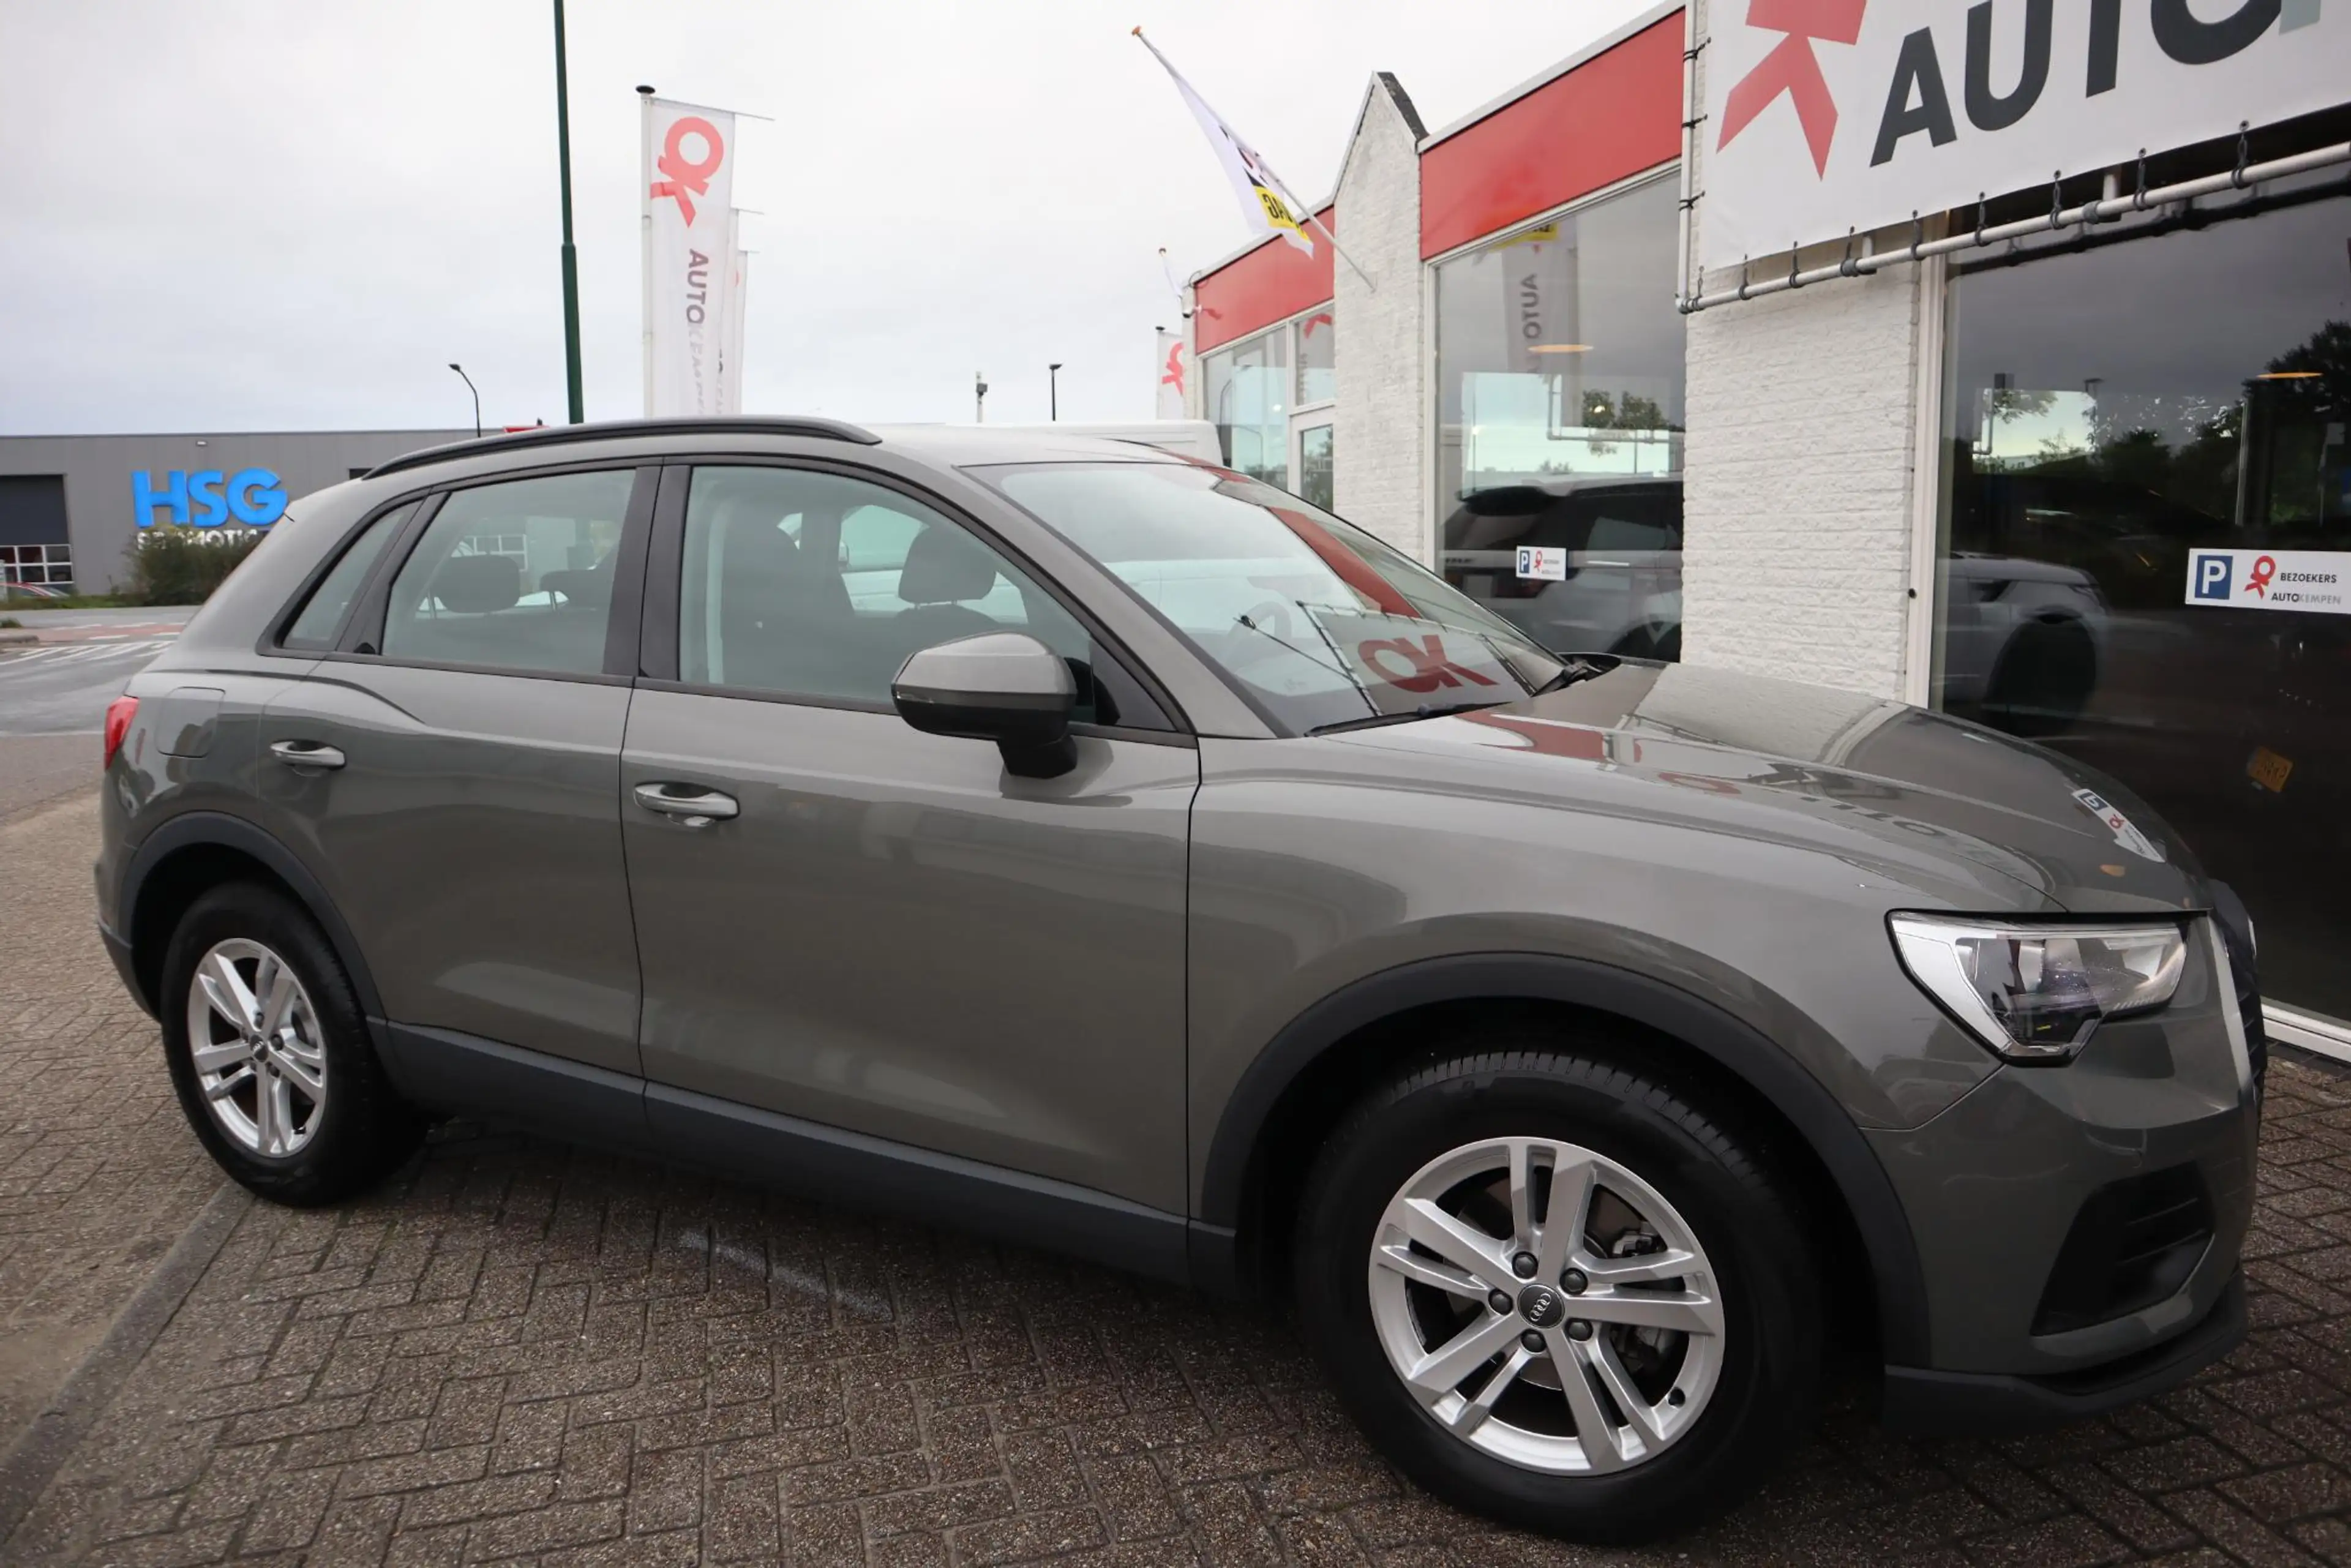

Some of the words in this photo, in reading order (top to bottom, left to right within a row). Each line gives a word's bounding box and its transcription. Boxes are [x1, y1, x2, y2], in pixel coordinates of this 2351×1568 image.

[131, 467, 289, 528] HSG
[2202, 560, 2227, 595] P
[2279, 572, 2338, 584] BEZOEKERS
